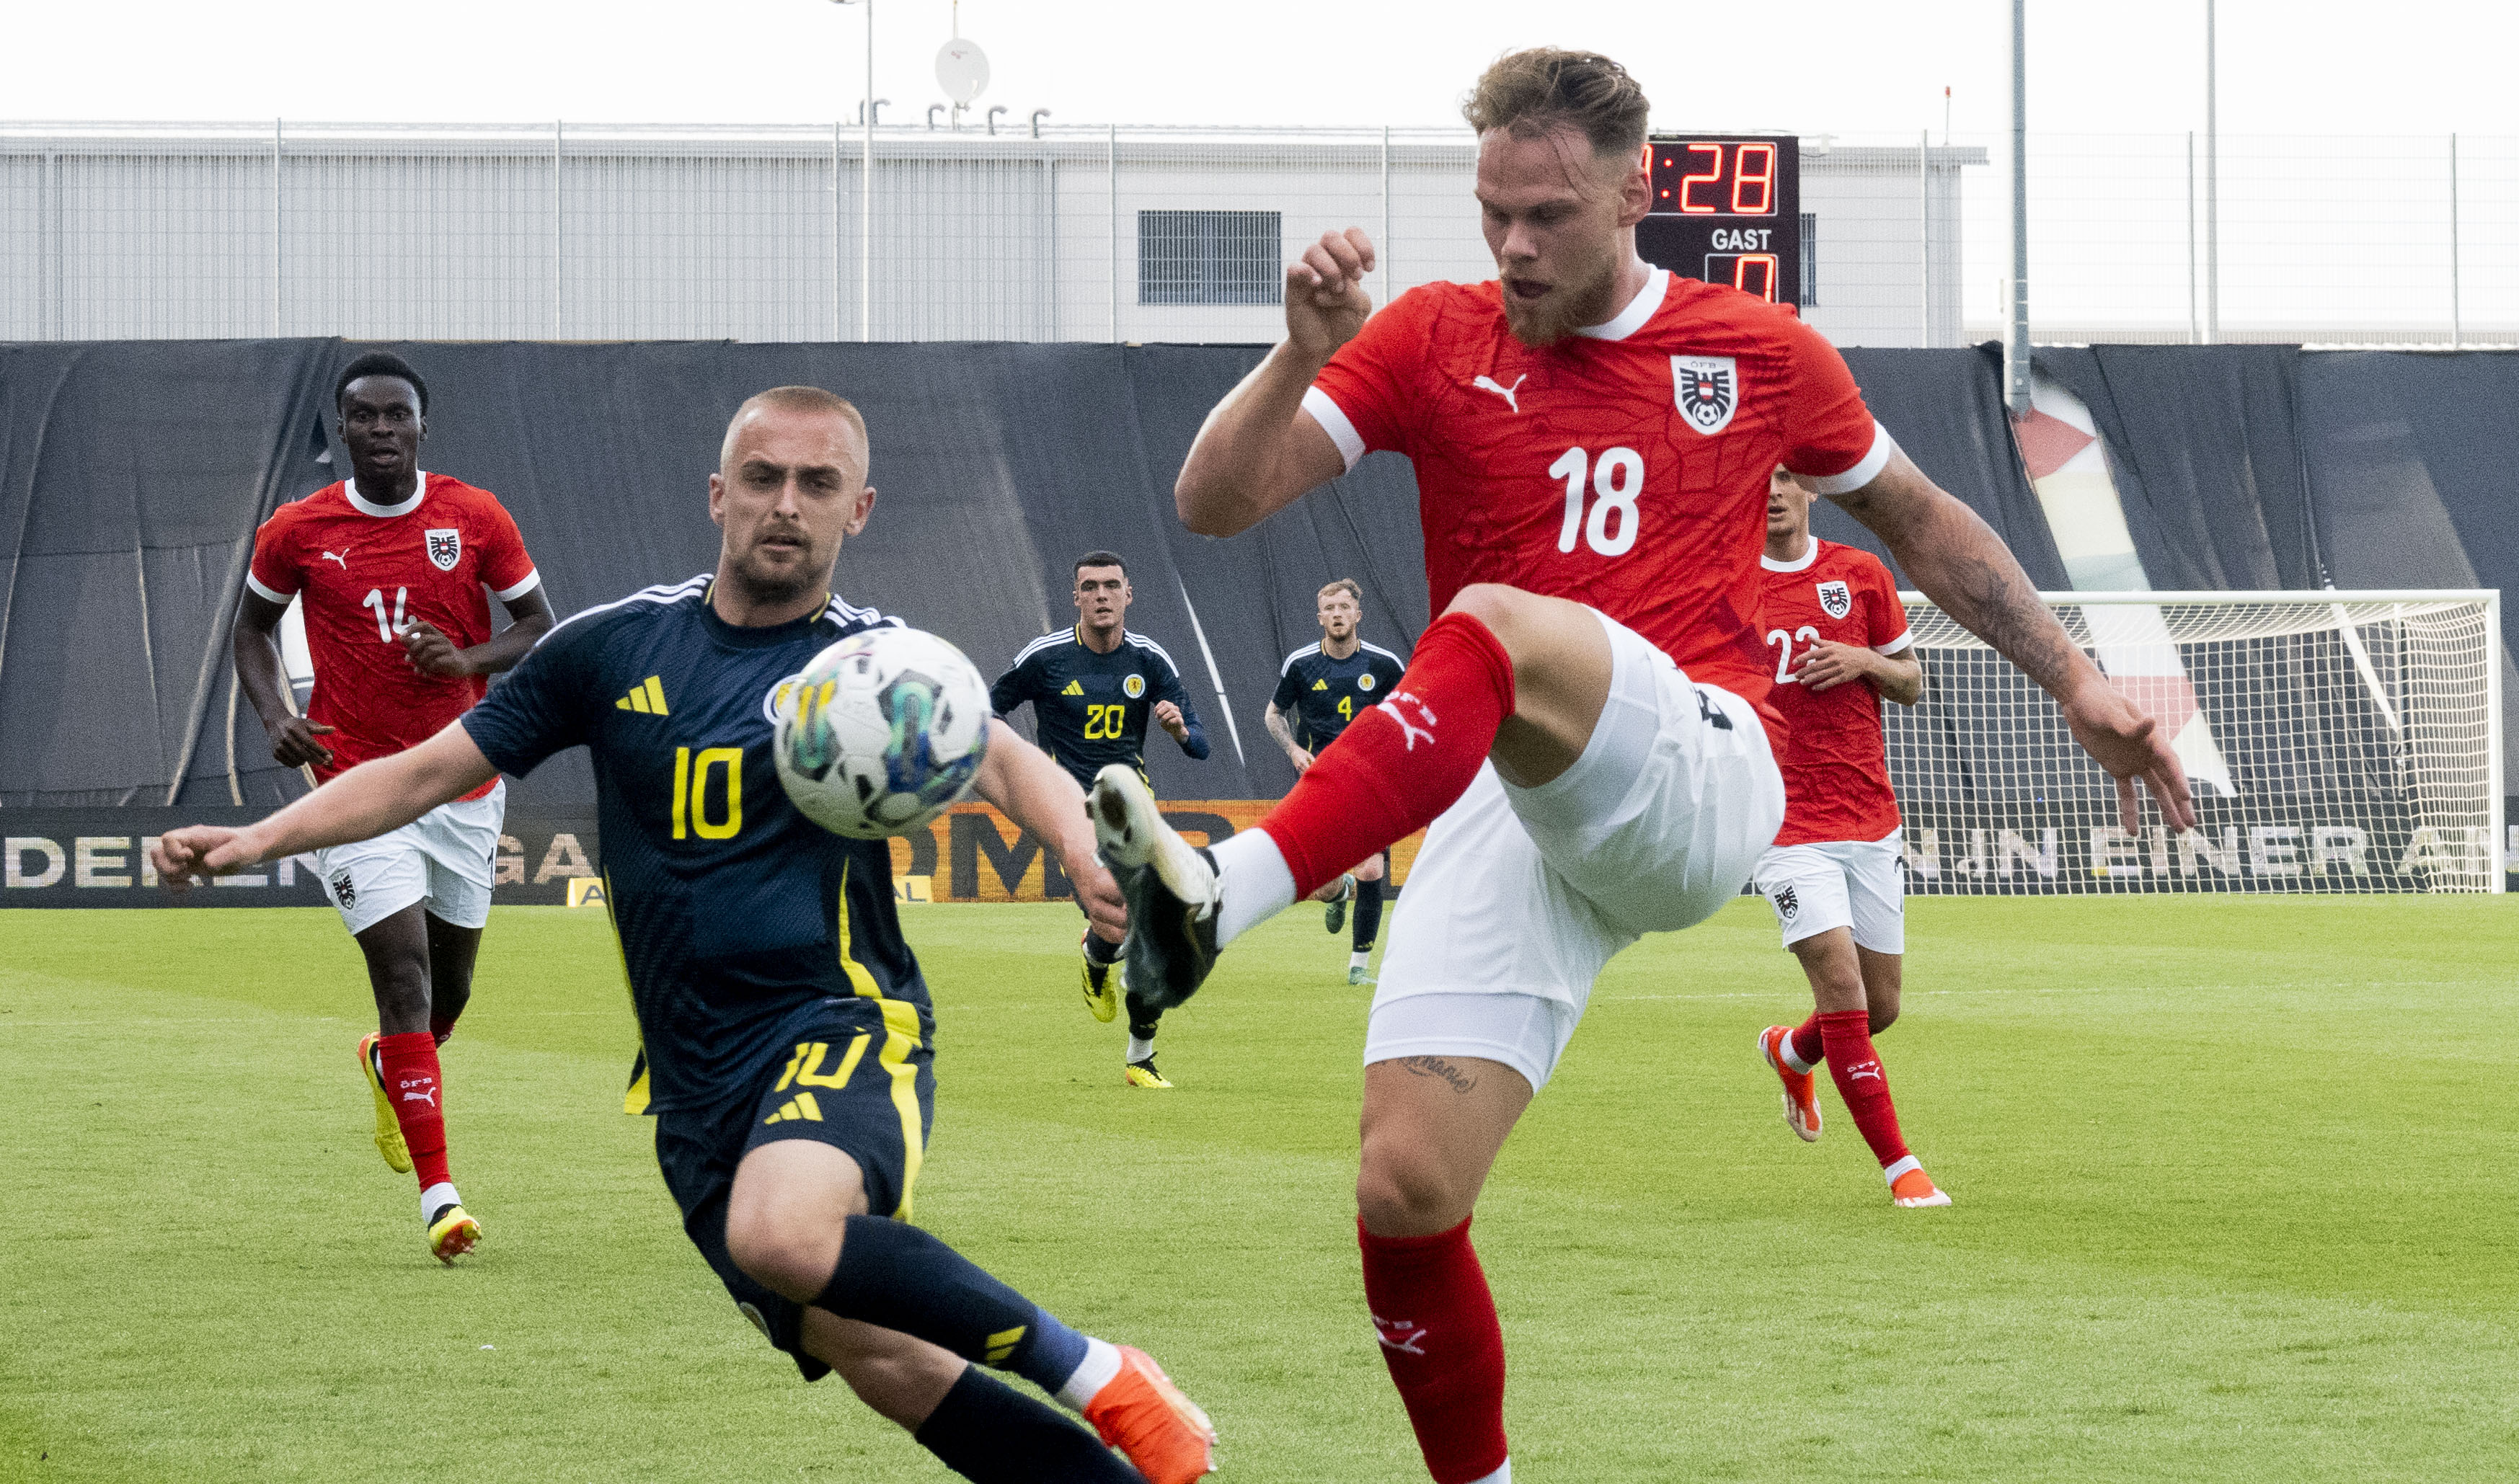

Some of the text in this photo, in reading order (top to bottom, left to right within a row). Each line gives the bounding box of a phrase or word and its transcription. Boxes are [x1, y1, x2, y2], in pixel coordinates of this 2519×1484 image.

[1712, 228, 1772, 250] GAST
[1549, 446, 1644, 556] 18
[363, 586, 421, 644] 14
[1084, 704, 1125, 739] 20
[1337, 696, 1353, 721] 4
[672, 746, 743, 840] 10
[2091, 826, 2368, 877] EINER
